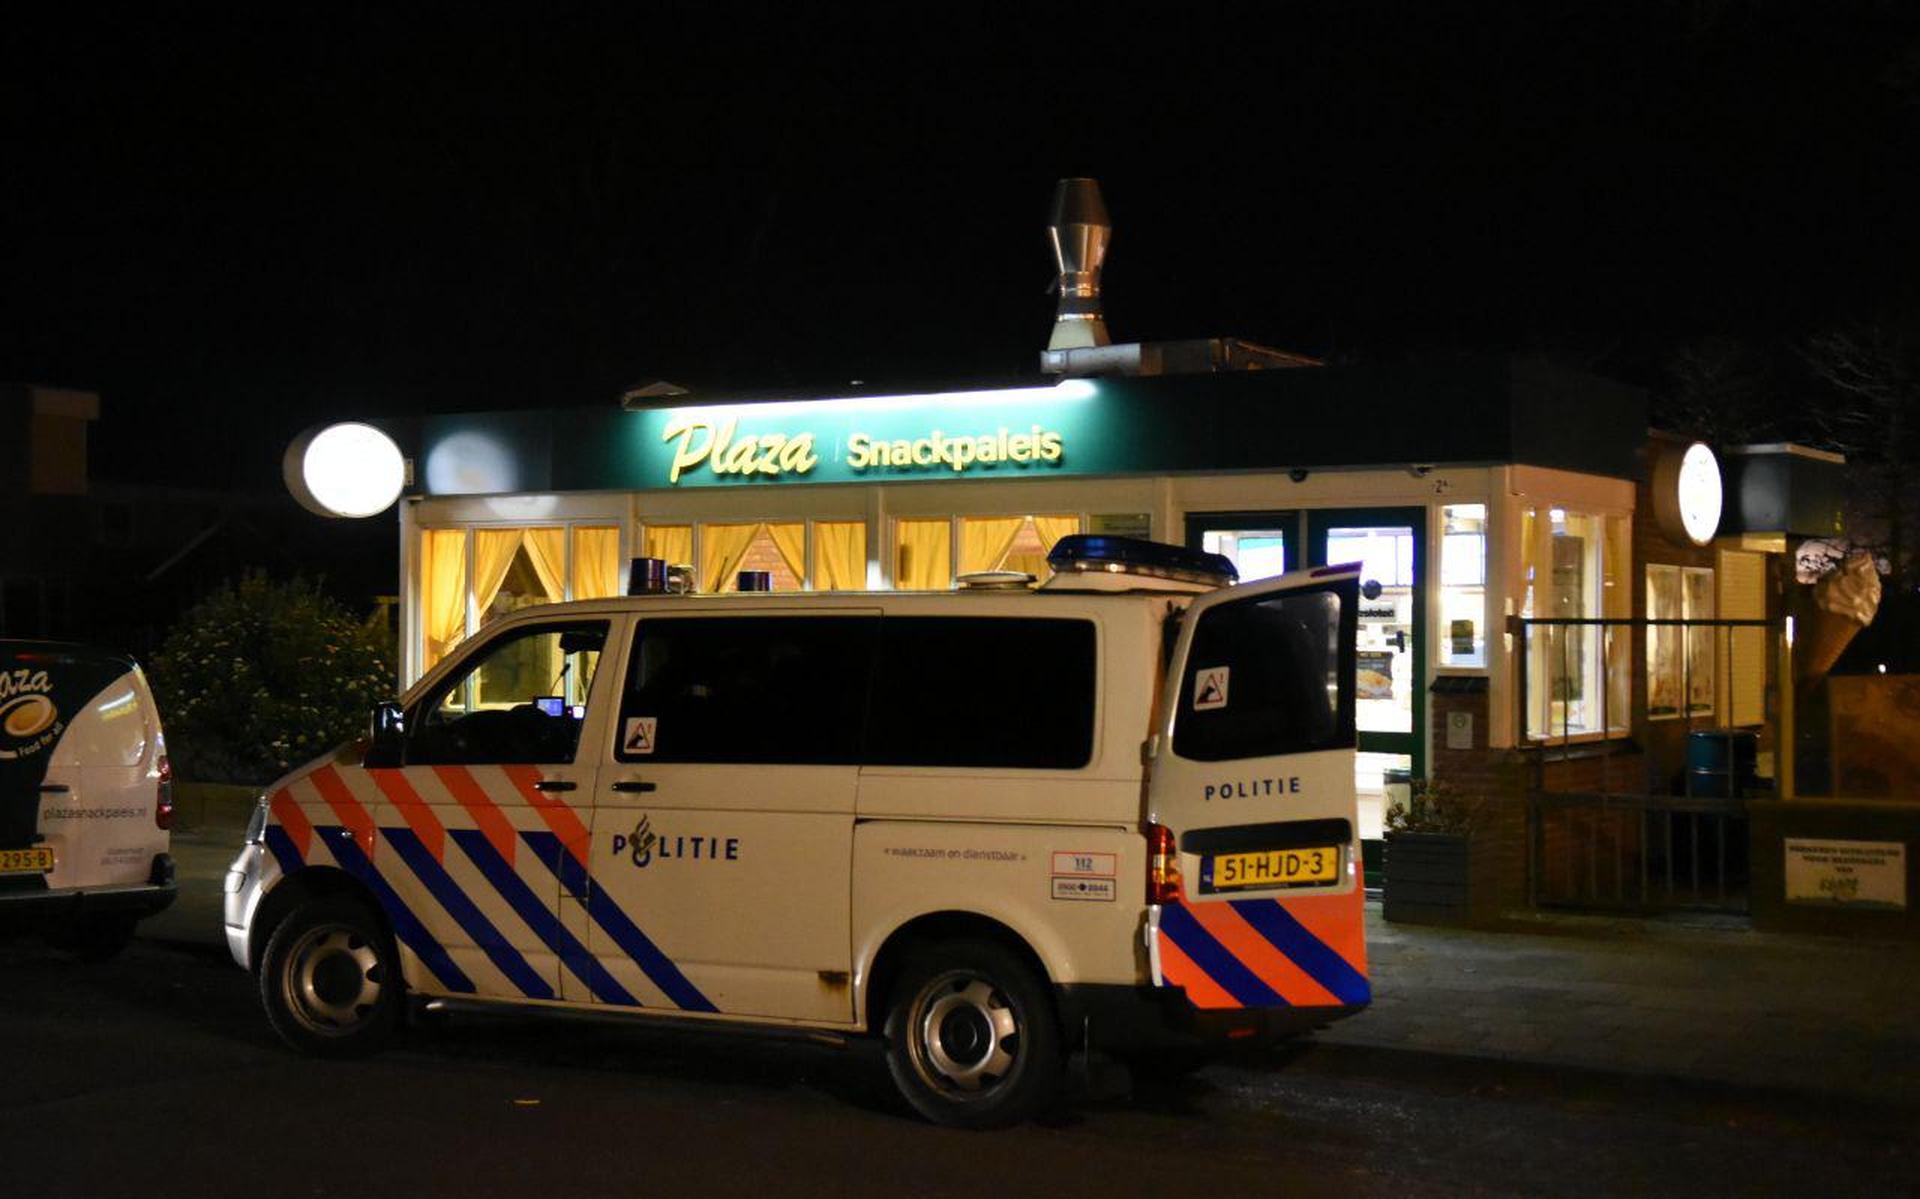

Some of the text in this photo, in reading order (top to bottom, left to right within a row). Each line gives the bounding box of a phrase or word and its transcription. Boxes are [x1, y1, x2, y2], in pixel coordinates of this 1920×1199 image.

[662, 416, 1062, 484] Plaza Snackpaleis
[1205, 777, 1301, 800] POLITIE
[612, 827, 739, 868] POLITIE
[1074, 857, 1093, 869] 112
[1224, 852, 1324, 881] 51-HJD-3
